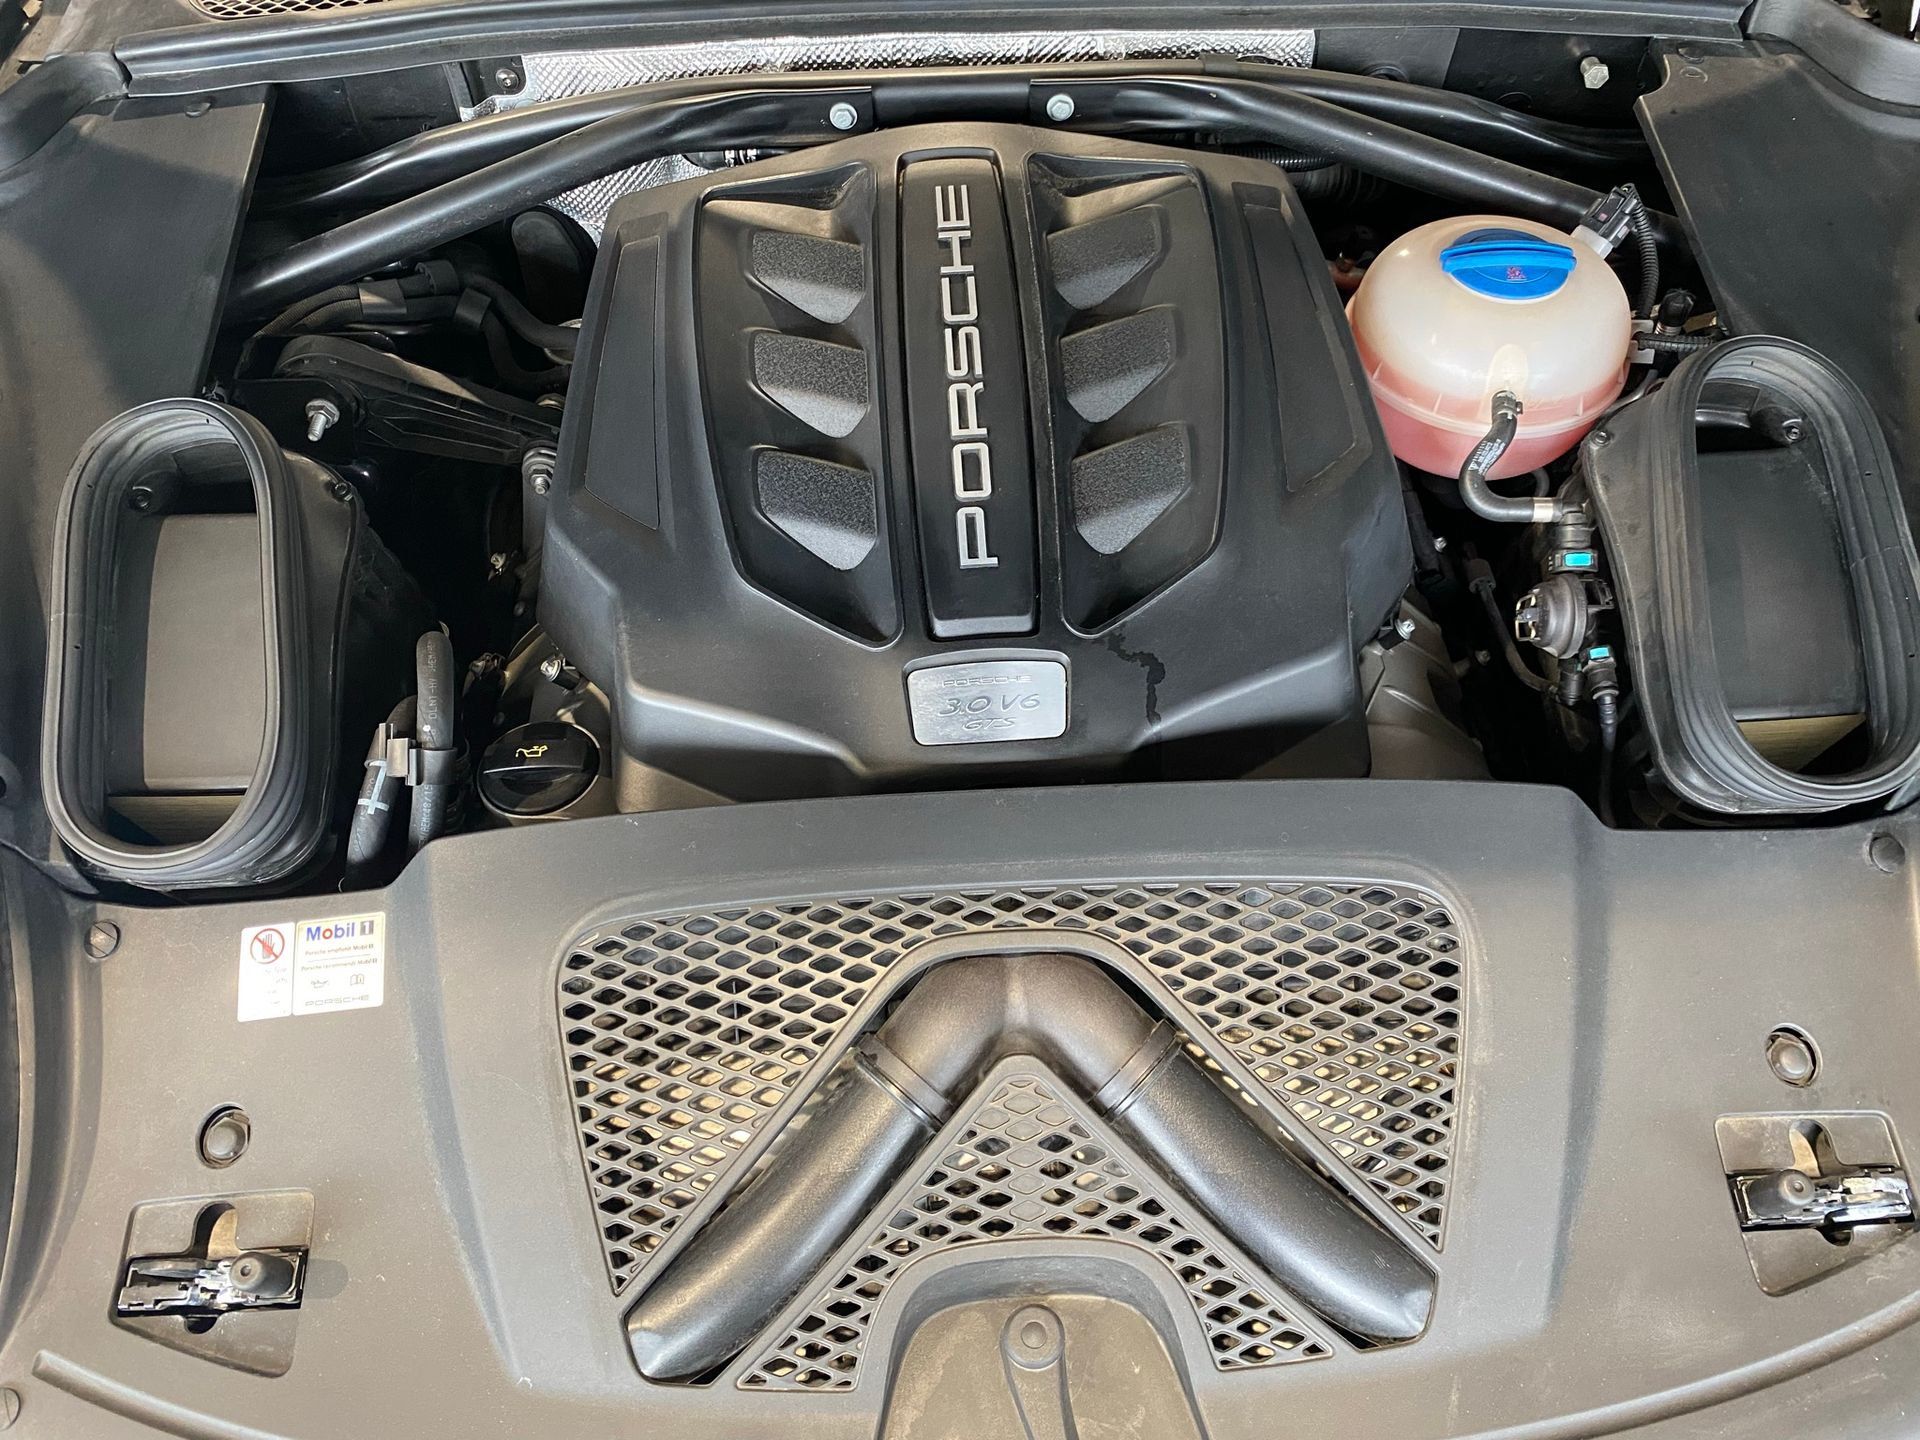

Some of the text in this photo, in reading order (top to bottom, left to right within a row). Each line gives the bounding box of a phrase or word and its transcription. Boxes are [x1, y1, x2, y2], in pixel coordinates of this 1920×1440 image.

[934, 184, 999, 569] PORSCHE
[941, 674, 1033, 688] PORSCHE
[938, 693, 1041, 717] 3.0 V6
[962, 716, 1017, 731] GTS
[306, 922, 355, 942] Mobil
[305, 994, 370, 1006] PORSCHE
